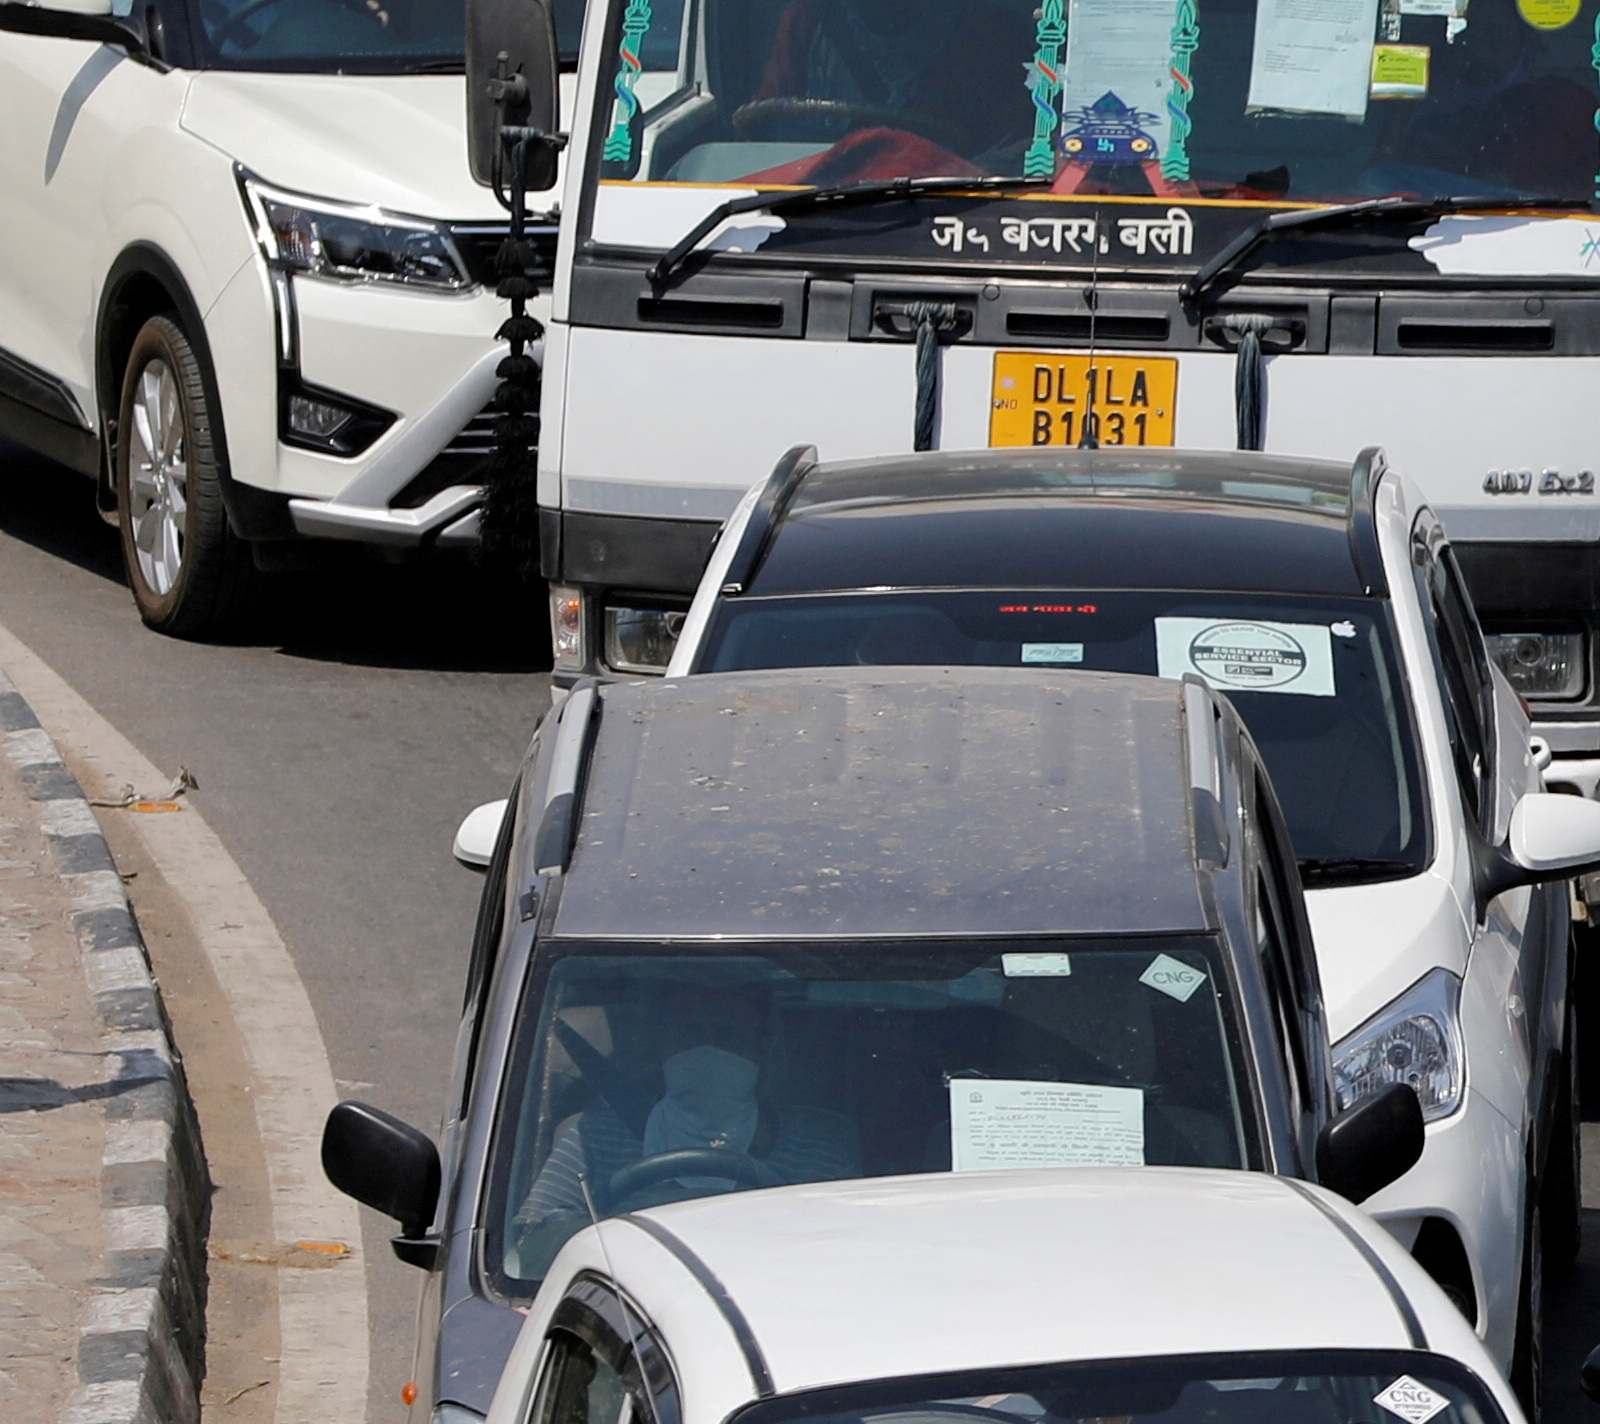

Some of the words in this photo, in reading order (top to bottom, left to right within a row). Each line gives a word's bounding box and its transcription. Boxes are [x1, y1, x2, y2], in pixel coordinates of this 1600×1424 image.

[1117, 208, 1194, 256] बली
[1152, 970, 1194, 985] CNG
[1389, 1390, 1432, 1404] CNG
